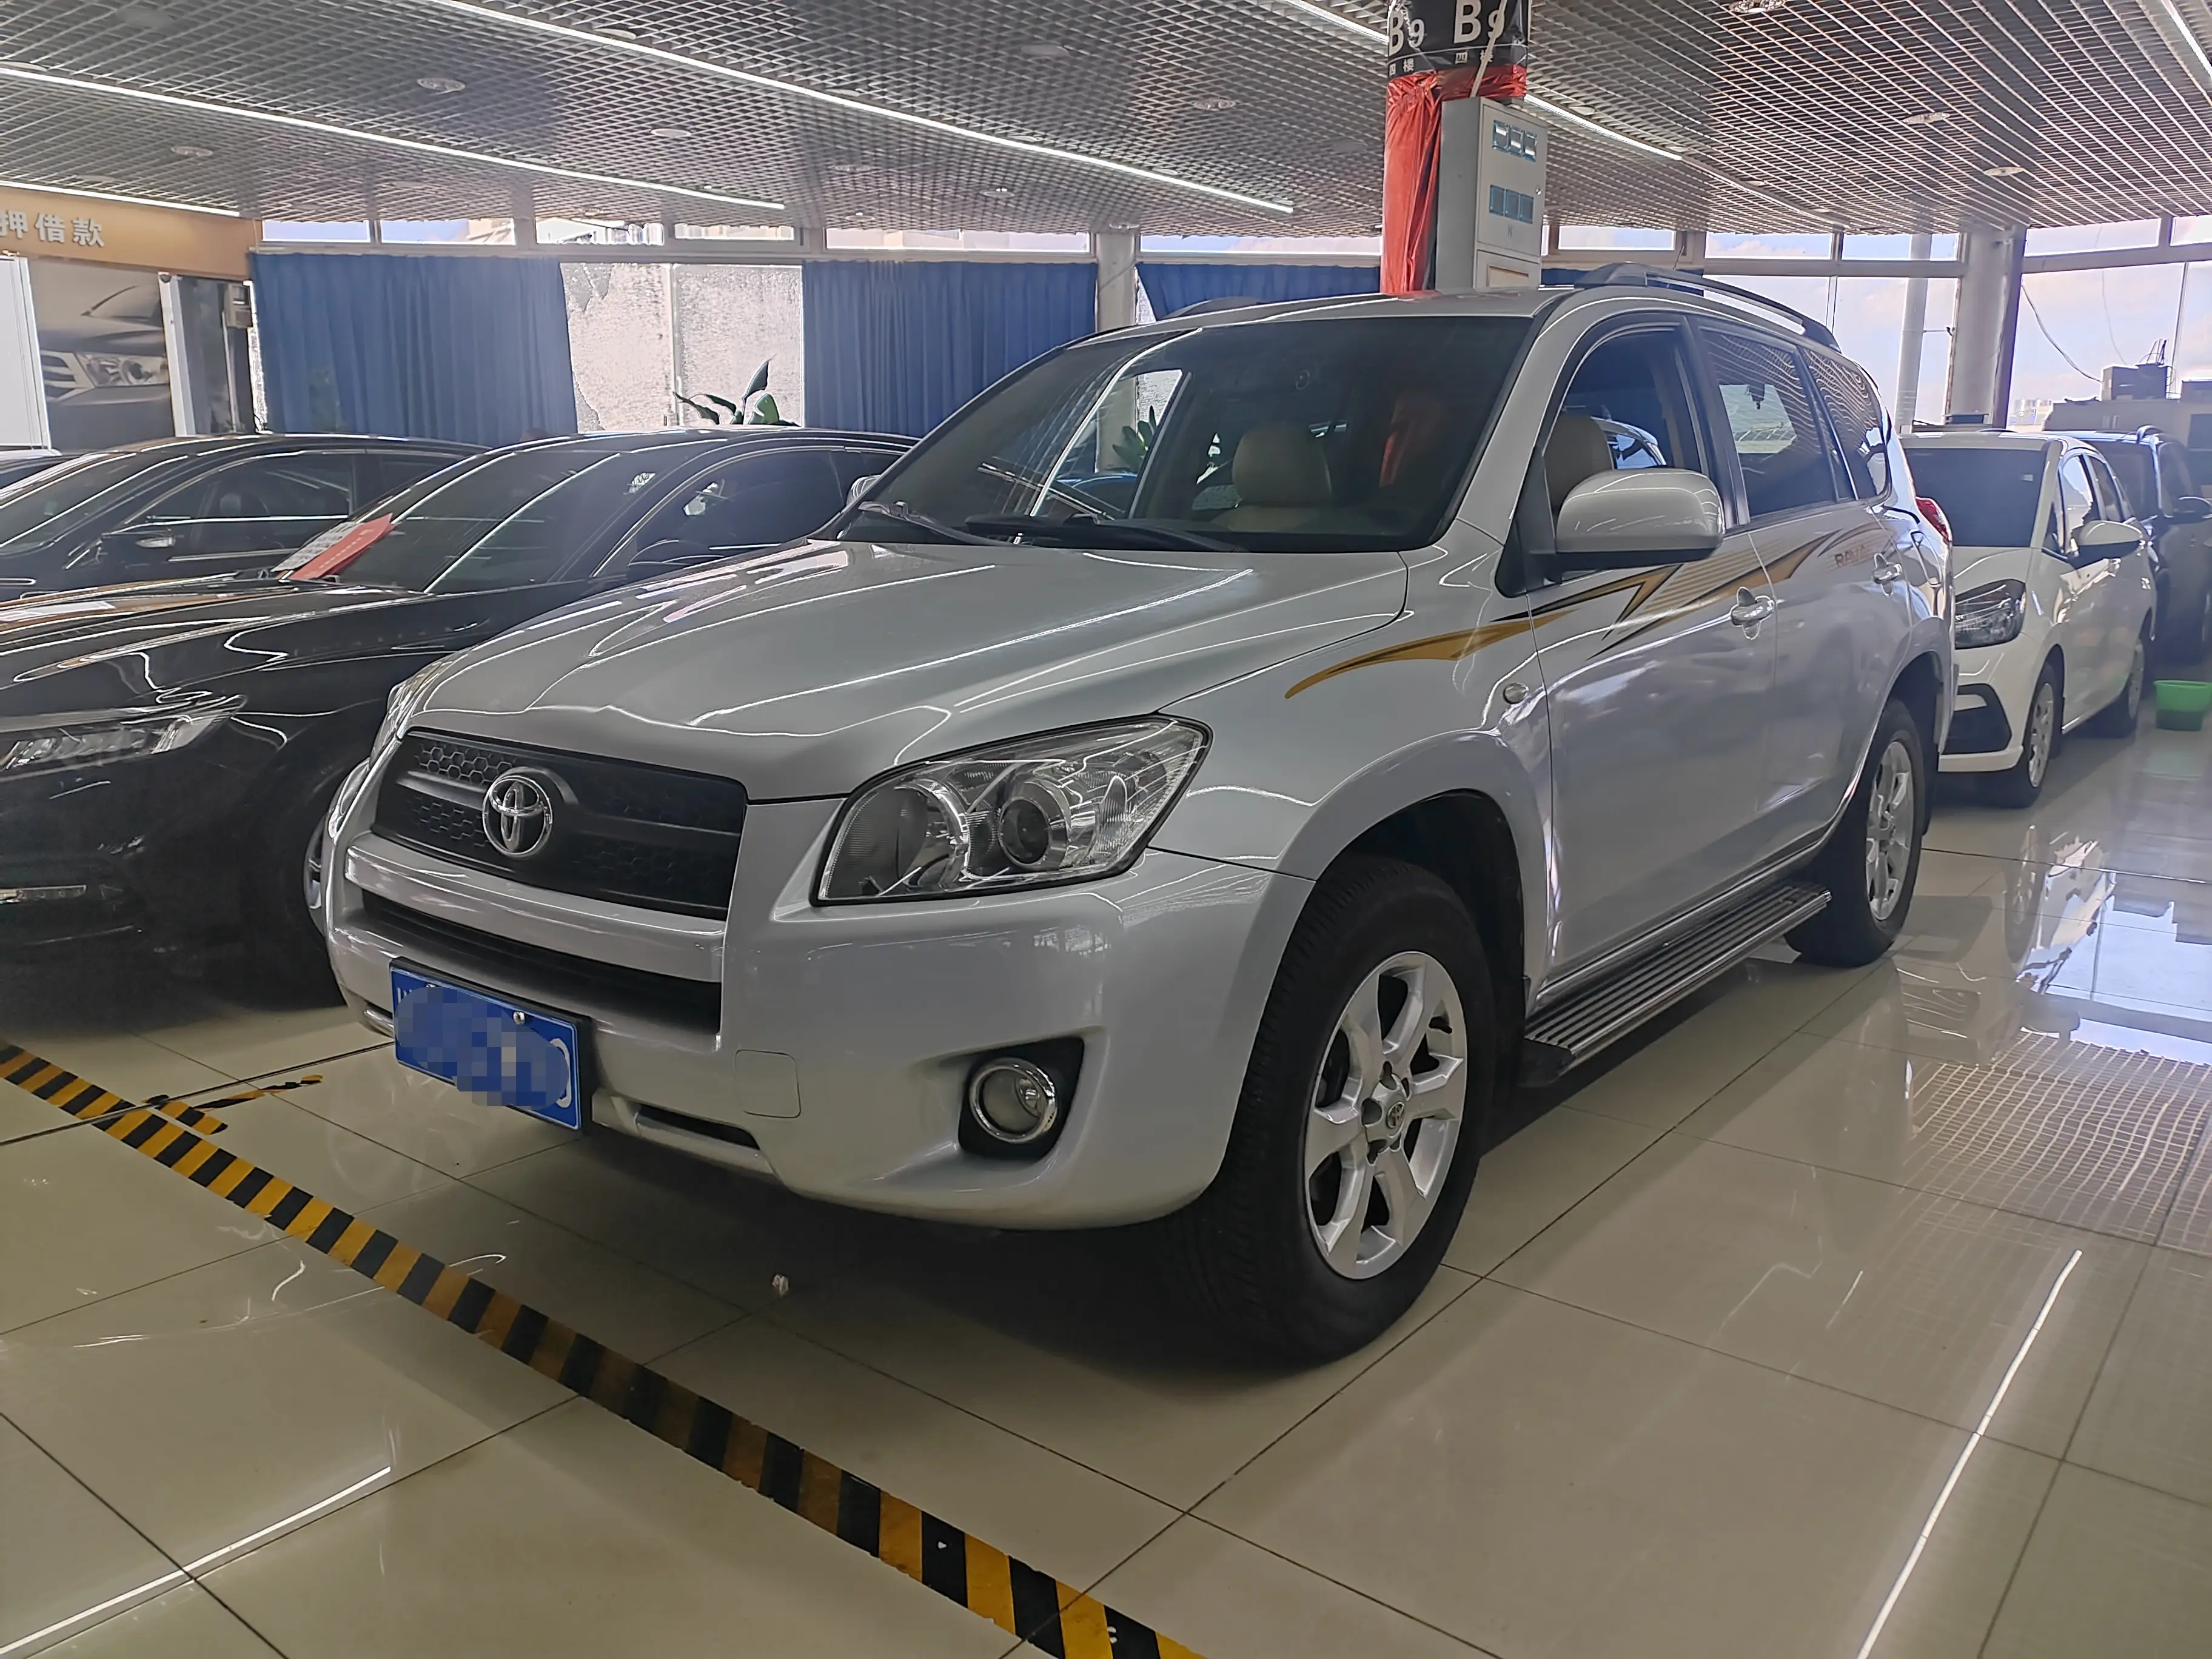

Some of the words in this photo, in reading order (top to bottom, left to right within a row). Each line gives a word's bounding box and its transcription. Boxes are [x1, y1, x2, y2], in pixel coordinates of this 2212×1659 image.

[1389, 9, 1424, 56] B9
[1454, 0, 1505, 44] B9
[1389, 58, 1414, 76] 四楼
[0, 209, 105, 247] 押借款
